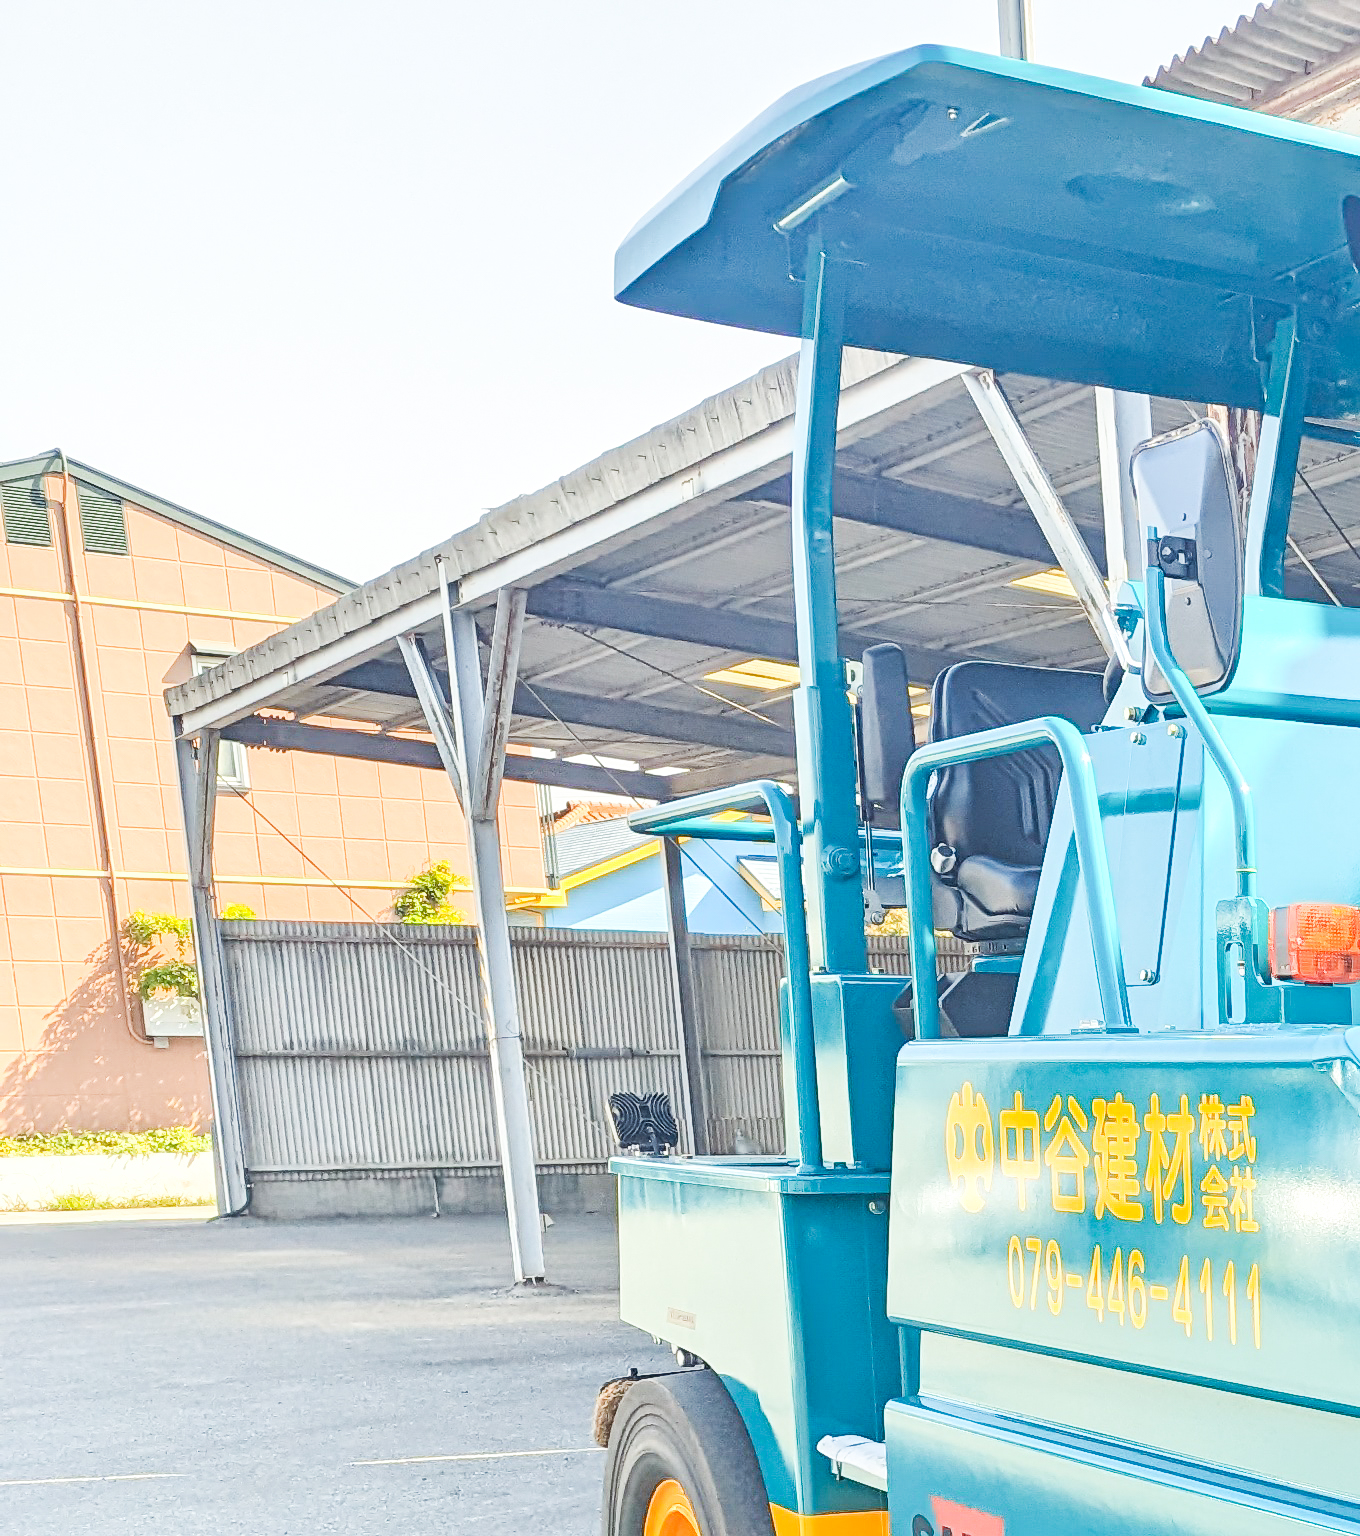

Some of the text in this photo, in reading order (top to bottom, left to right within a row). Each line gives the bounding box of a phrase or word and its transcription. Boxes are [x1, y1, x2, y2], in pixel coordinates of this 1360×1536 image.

[999, 1090, 1195, 1225] 中谷建材
[1007, 1235, 1260, 1350] 079-446-4111
